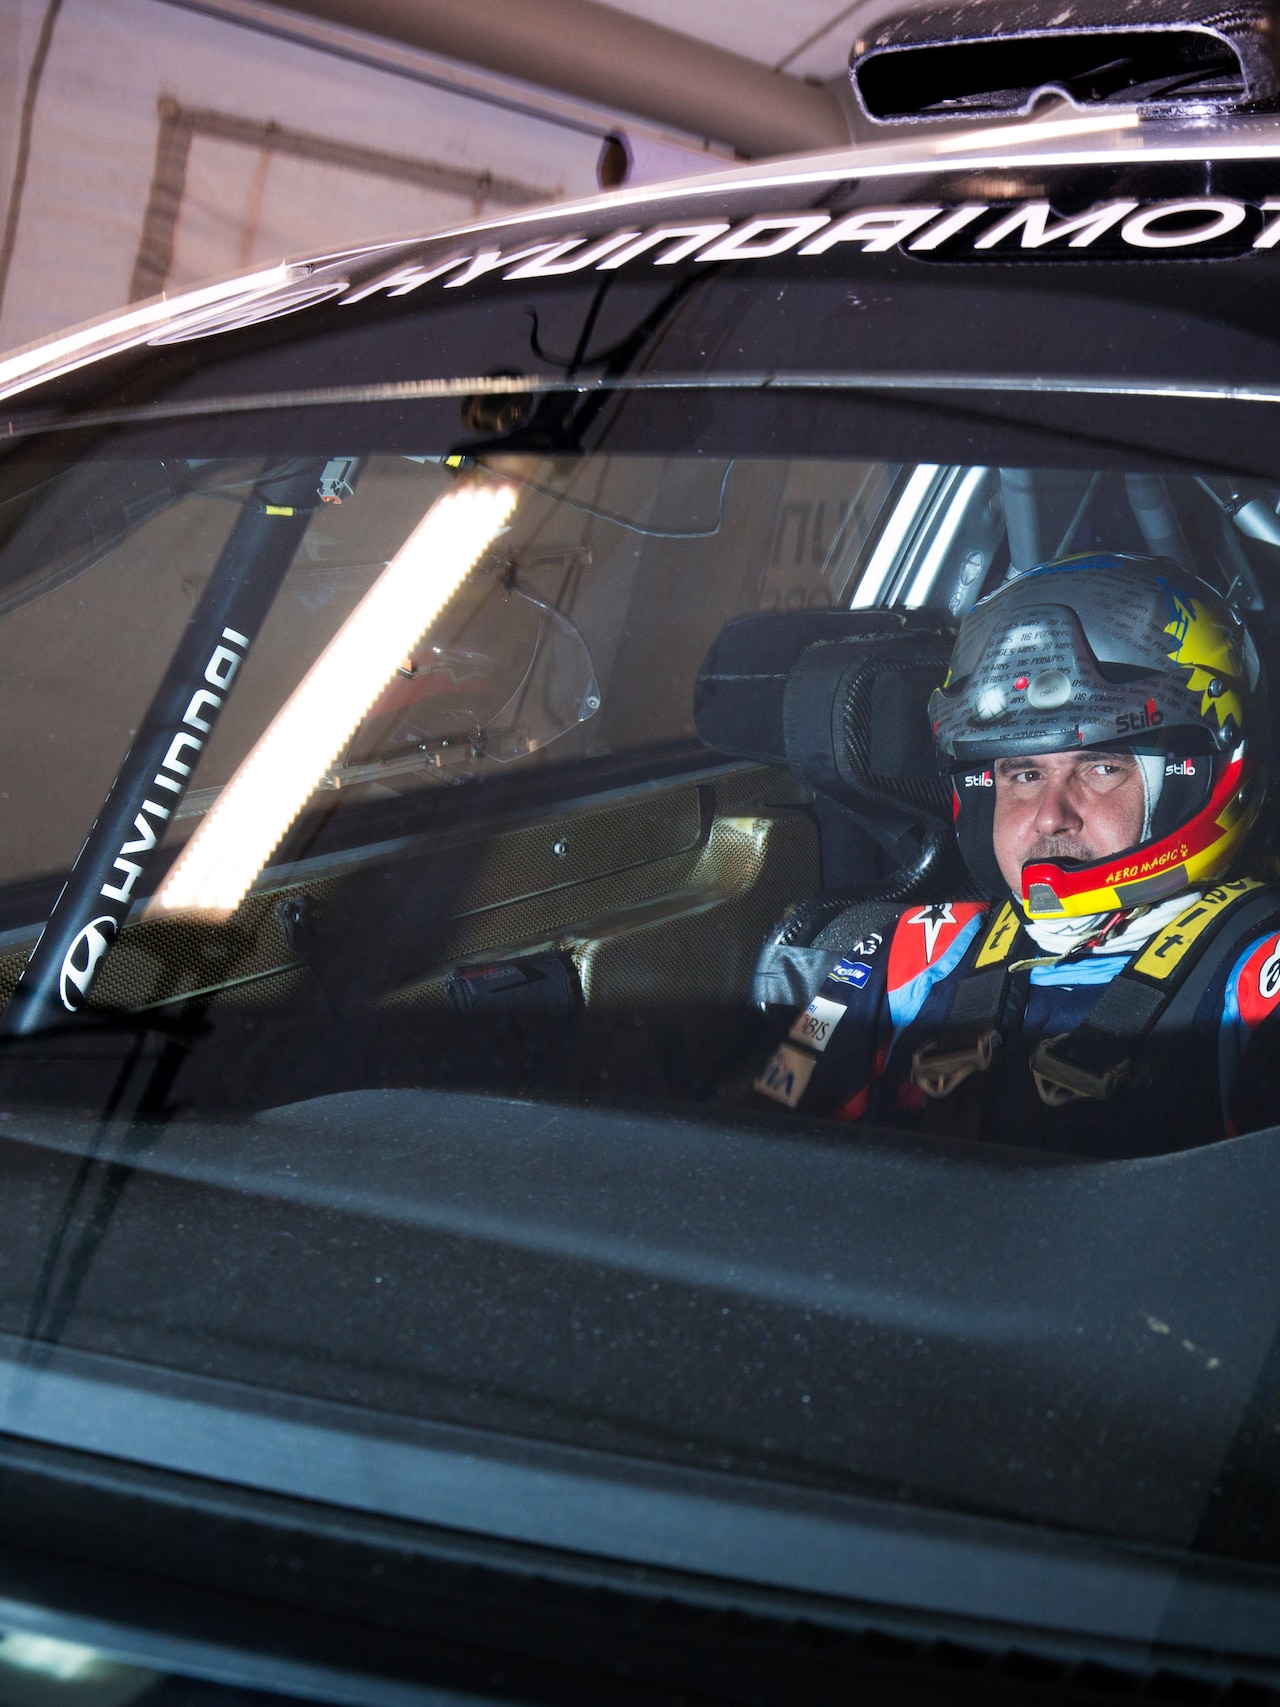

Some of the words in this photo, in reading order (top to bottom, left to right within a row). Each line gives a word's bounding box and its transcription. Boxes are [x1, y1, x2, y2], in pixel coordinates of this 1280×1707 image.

[338, 204, 988, 305] HYUNDAI
[100, 626, 250, 905] HYUNDAI
[1105, 864, 1138, 884] AERO
[1140, 848, 1178, 873] MAGIC
